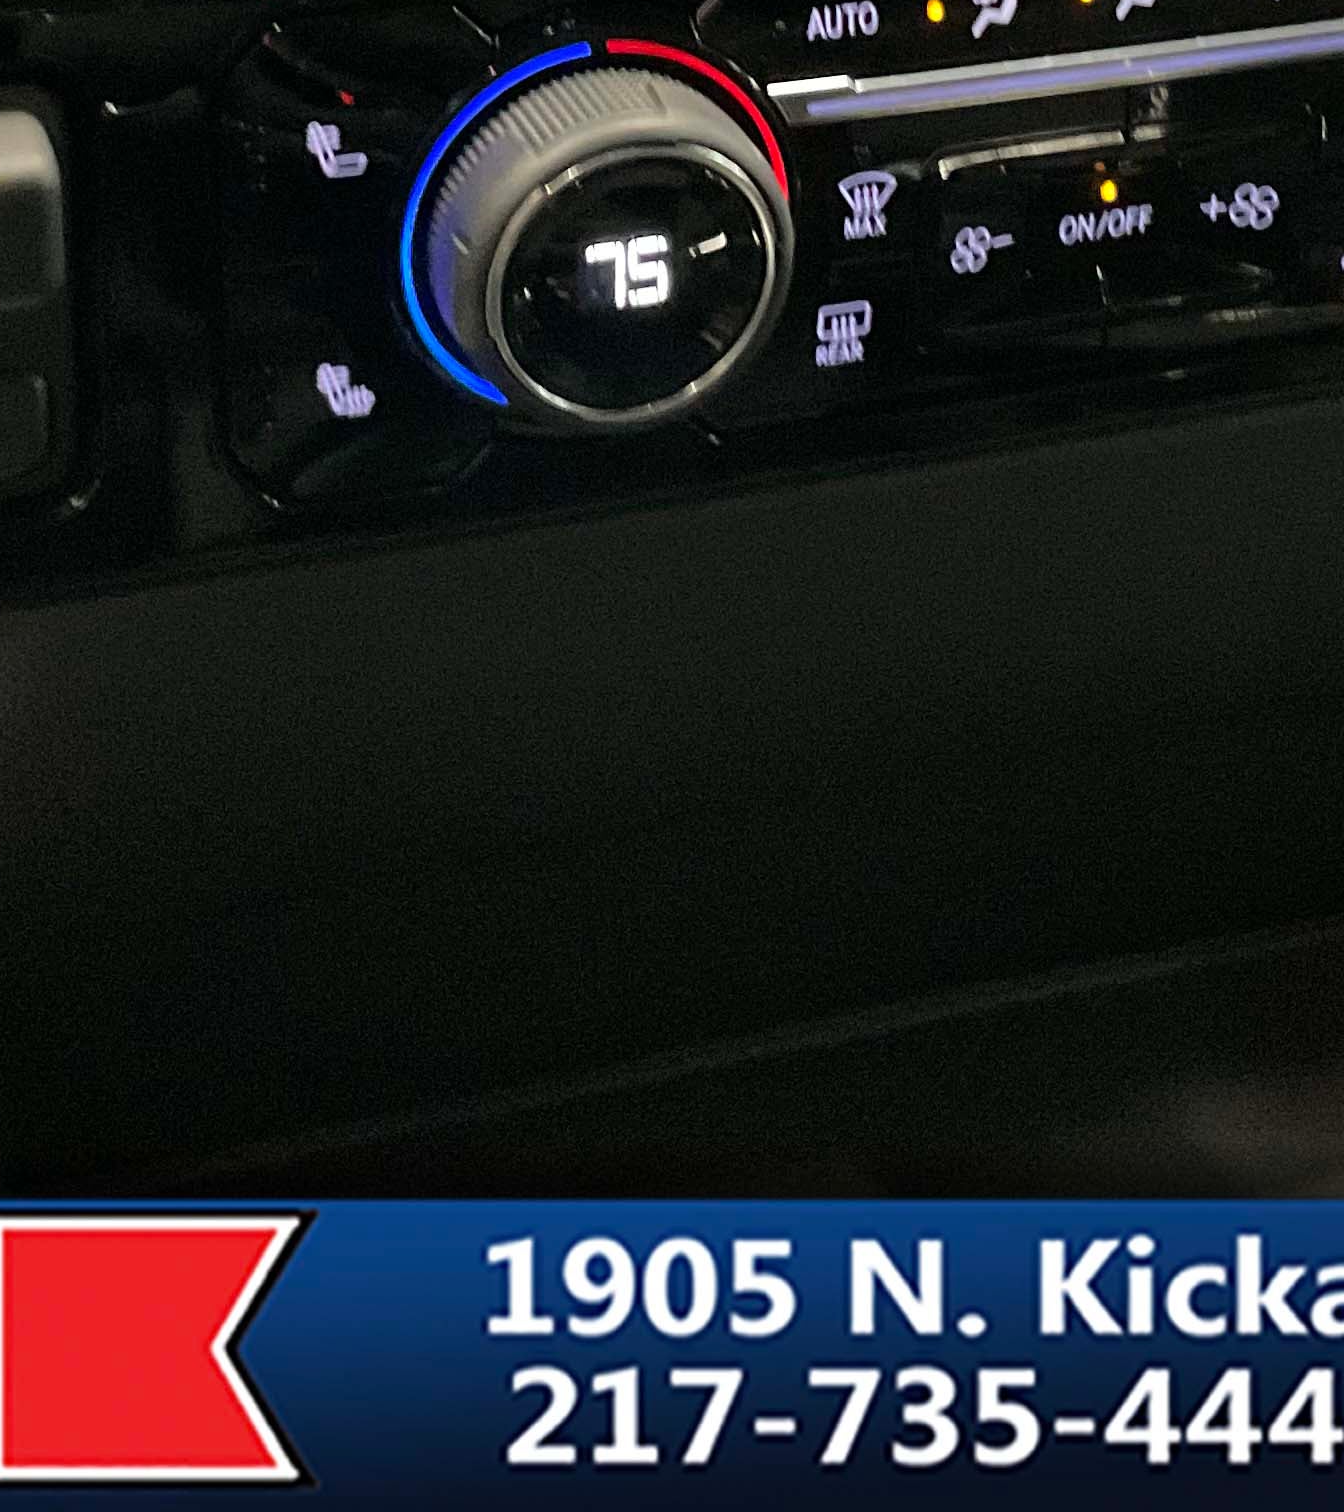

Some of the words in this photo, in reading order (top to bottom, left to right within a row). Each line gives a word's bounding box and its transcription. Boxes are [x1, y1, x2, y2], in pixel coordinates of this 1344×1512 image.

[805, 0, 880, 43] AUTO
[1058, 202, 1153, 245] ON/OFF
[583, 233, 670, 310] 75
